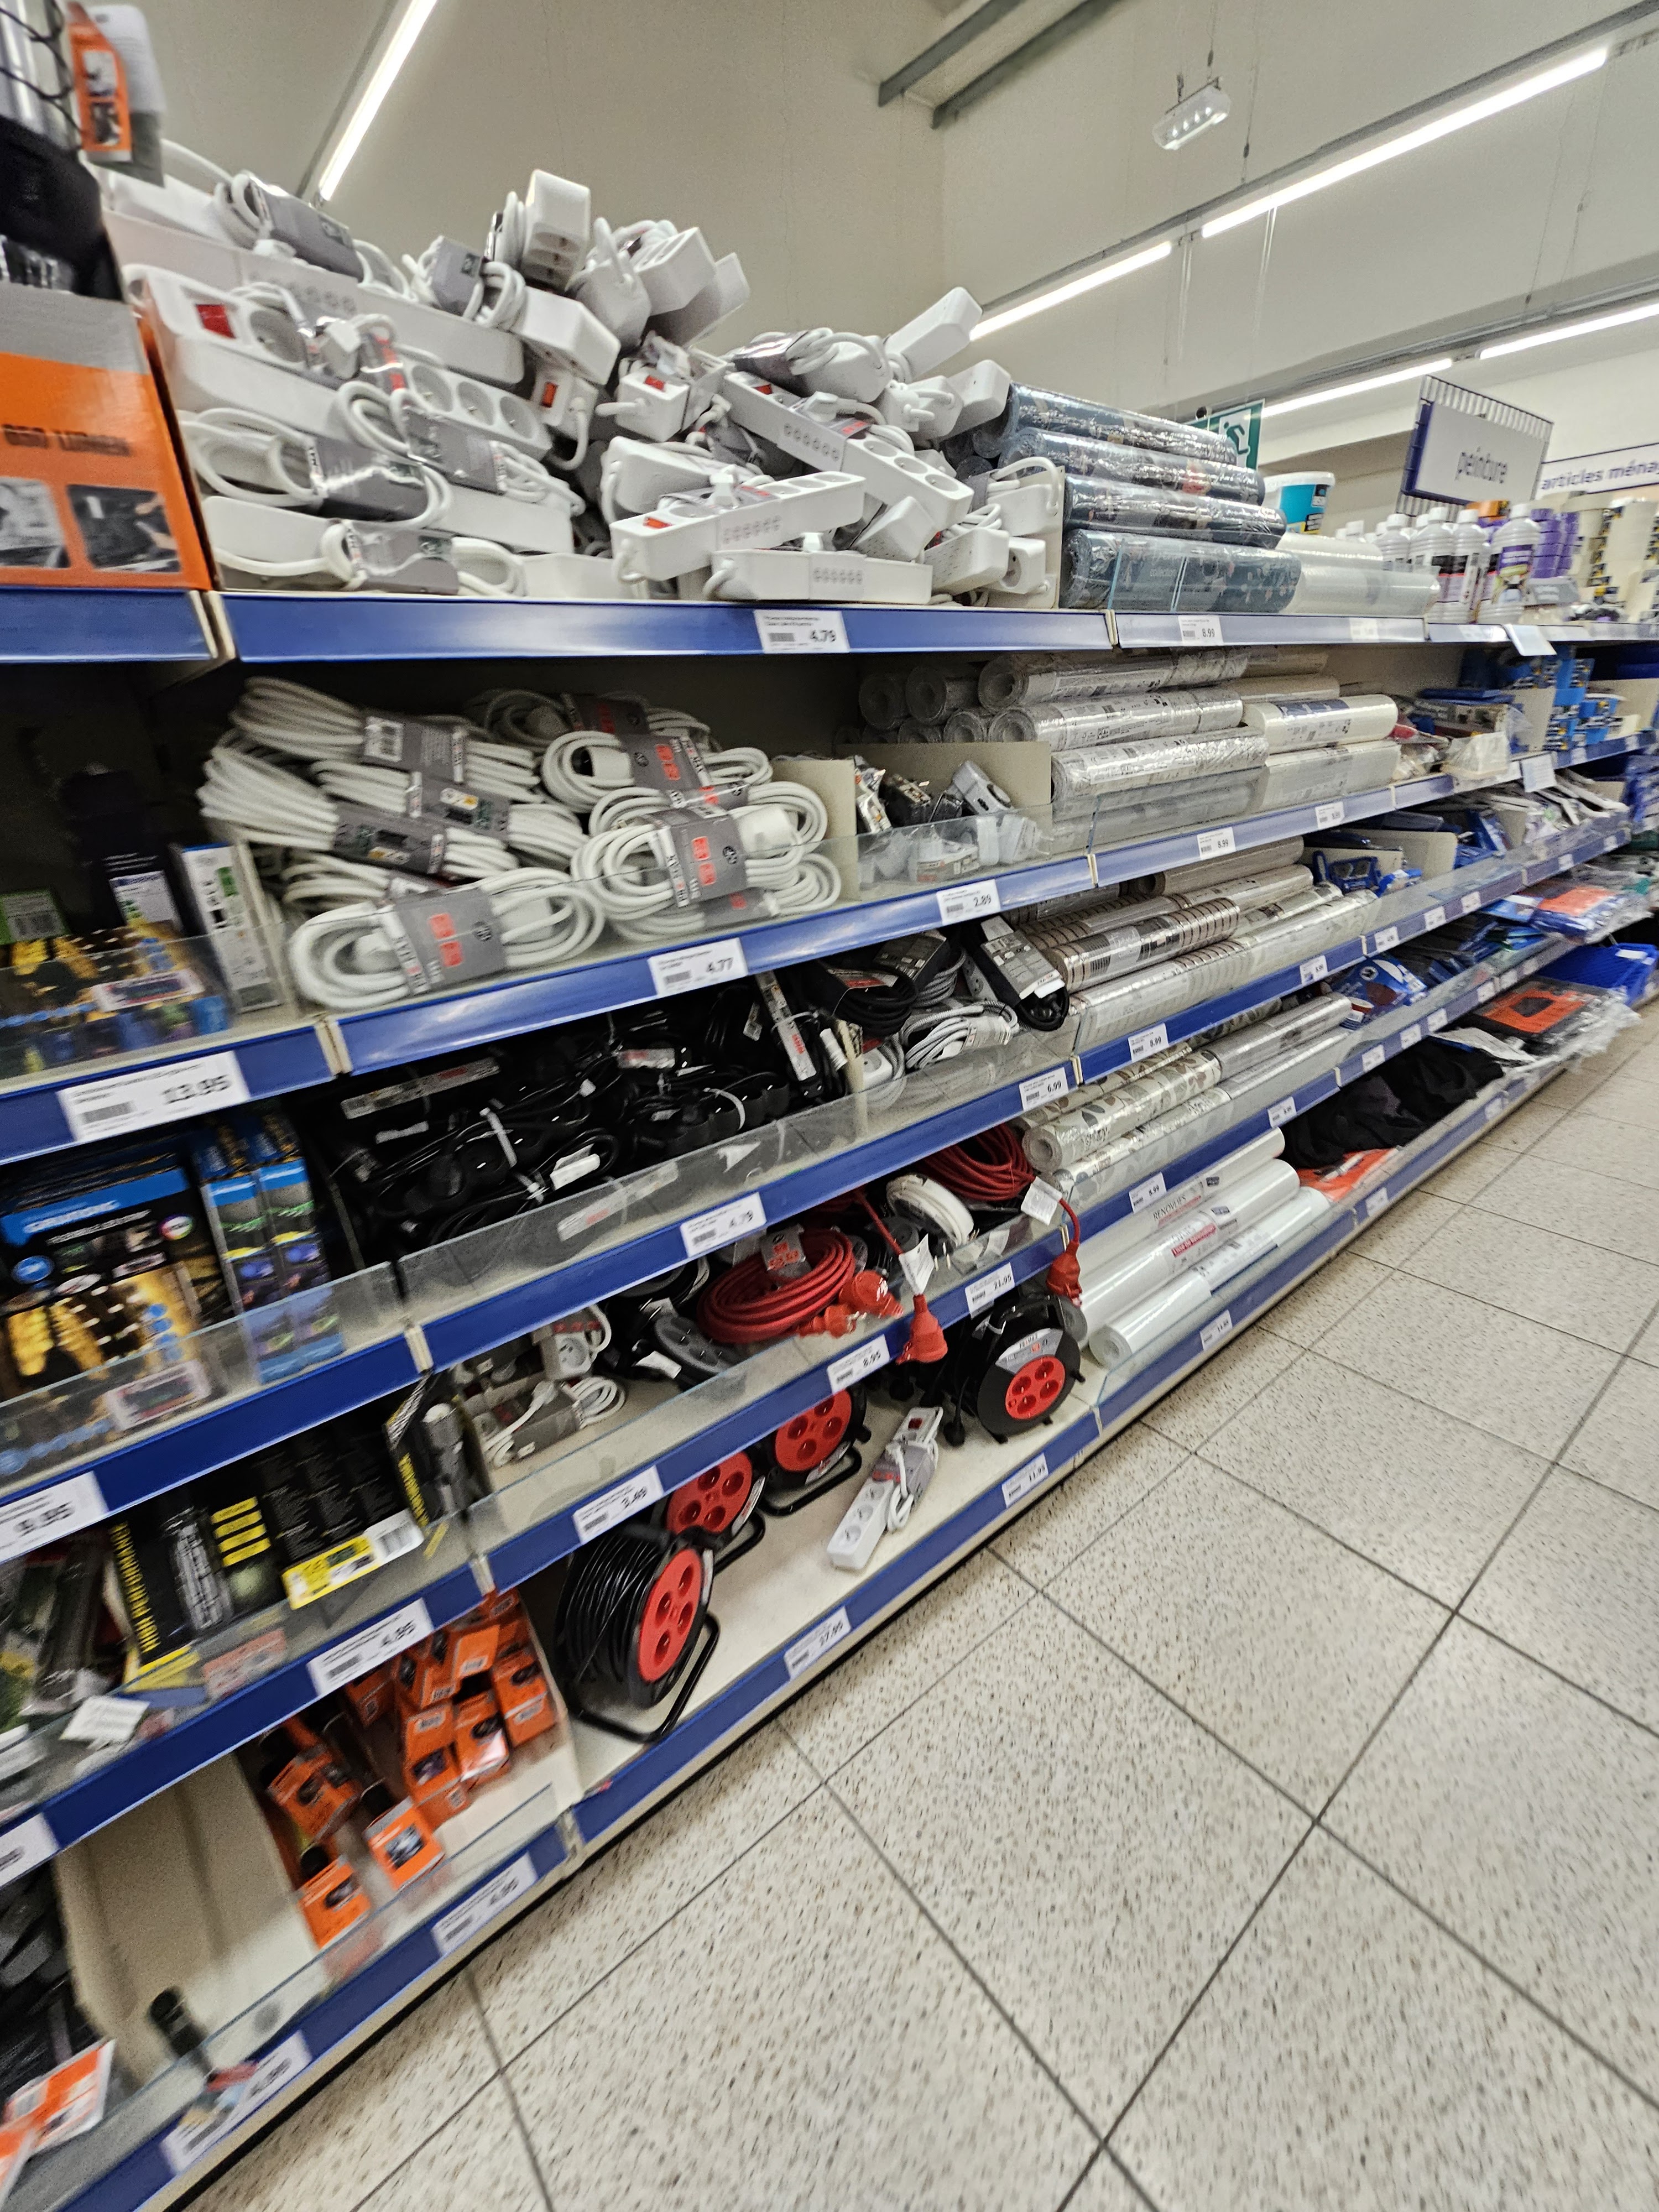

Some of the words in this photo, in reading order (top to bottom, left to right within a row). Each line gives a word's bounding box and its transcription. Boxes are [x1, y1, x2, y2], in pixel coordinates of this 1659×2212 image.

[1454, 446, 1507, 484] peinture
[1541, 468, 1603, 489] articles
[1202, 628, 1215, 638] 8.99
[1217, 838, 1229, 848] 8.99
[706, 957, 734, 974] 4.77
[1047, 1079, 1062, 1093] 6.99
[994, 1274, 1012, 1291] 21.95
